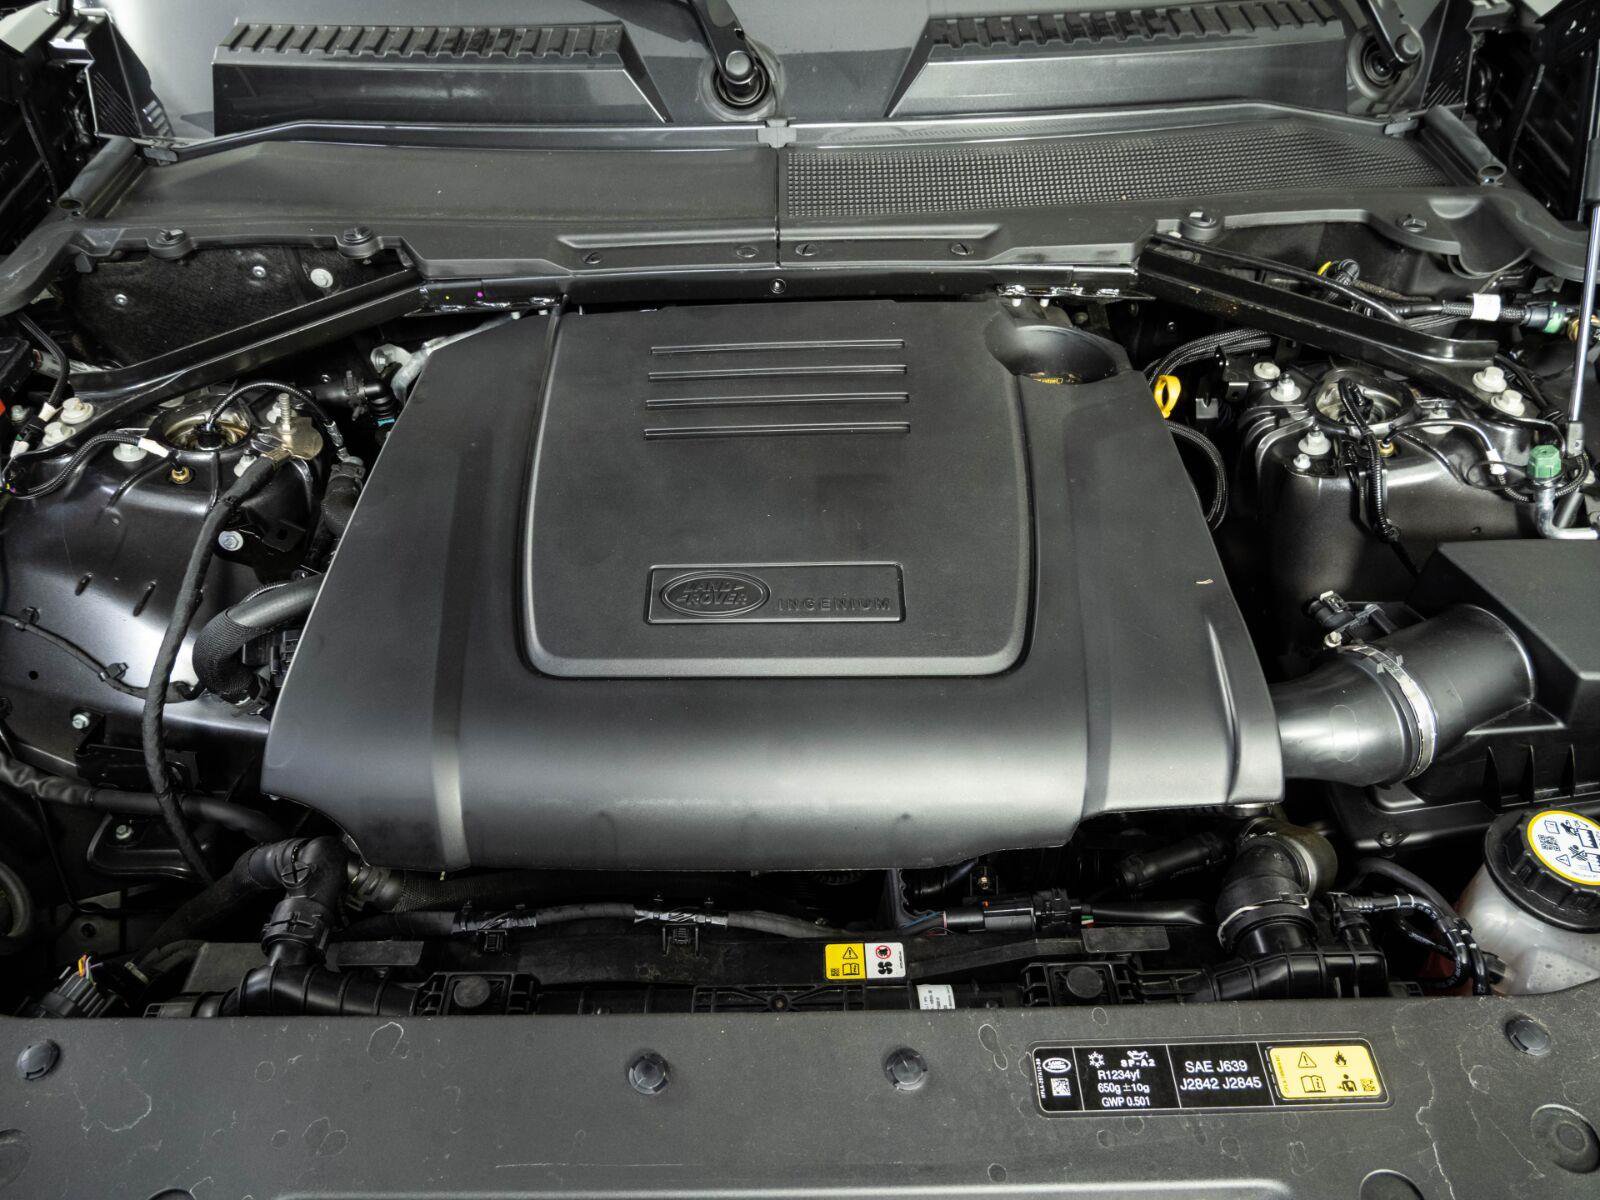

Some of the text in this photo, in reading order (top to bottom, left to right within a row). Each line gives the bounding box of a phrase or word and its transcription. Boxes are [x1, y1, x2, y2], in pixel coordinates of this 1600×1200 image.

[776, 597, 892, 612] INGENIUM
[1120, 1059, 1156, 1067] SP-A2
[1184, 1060, 1248, 1073] SAE J639
[1097, 1069, 1141, 1081] R1234yf
[1097, 1082, 1150, 1094] 650g ±10g
[1180, 1076, 1262, 1091] J2842 J2845
[1101, 1096, 1151, 1107] GWP 0.501
